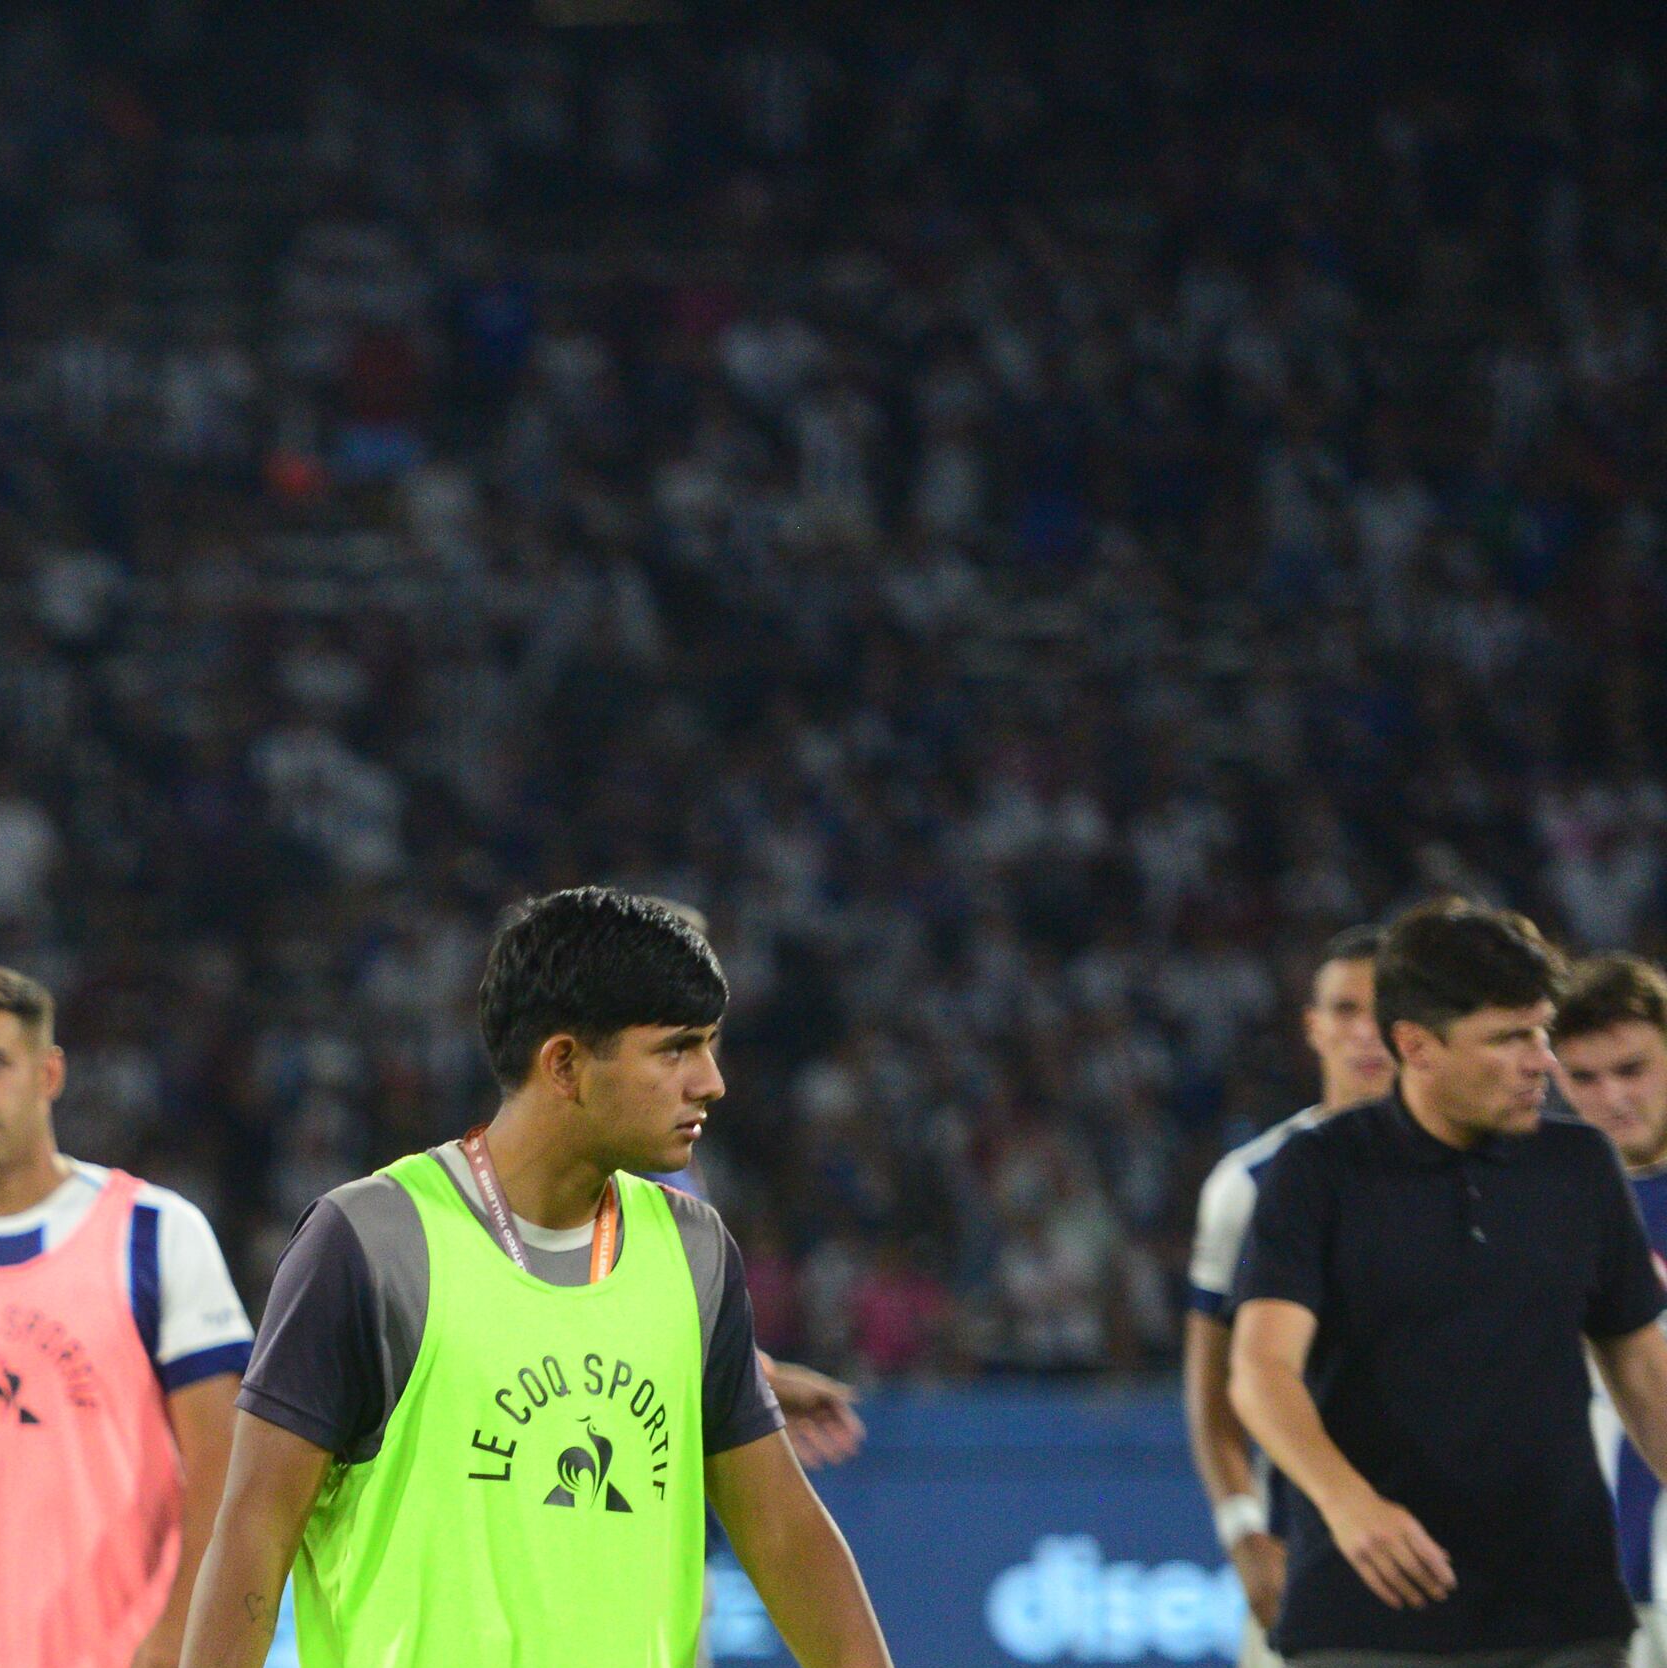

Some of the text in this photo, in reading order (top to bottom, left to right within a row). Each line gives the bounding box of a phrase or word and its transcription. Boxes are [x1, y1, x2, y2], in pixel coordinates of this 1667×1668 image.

[478, 1168, 507, 1229] TALLERES
[468, 1430, 517, 1482] LE
[495, 1355, 571, 1425] COQ
